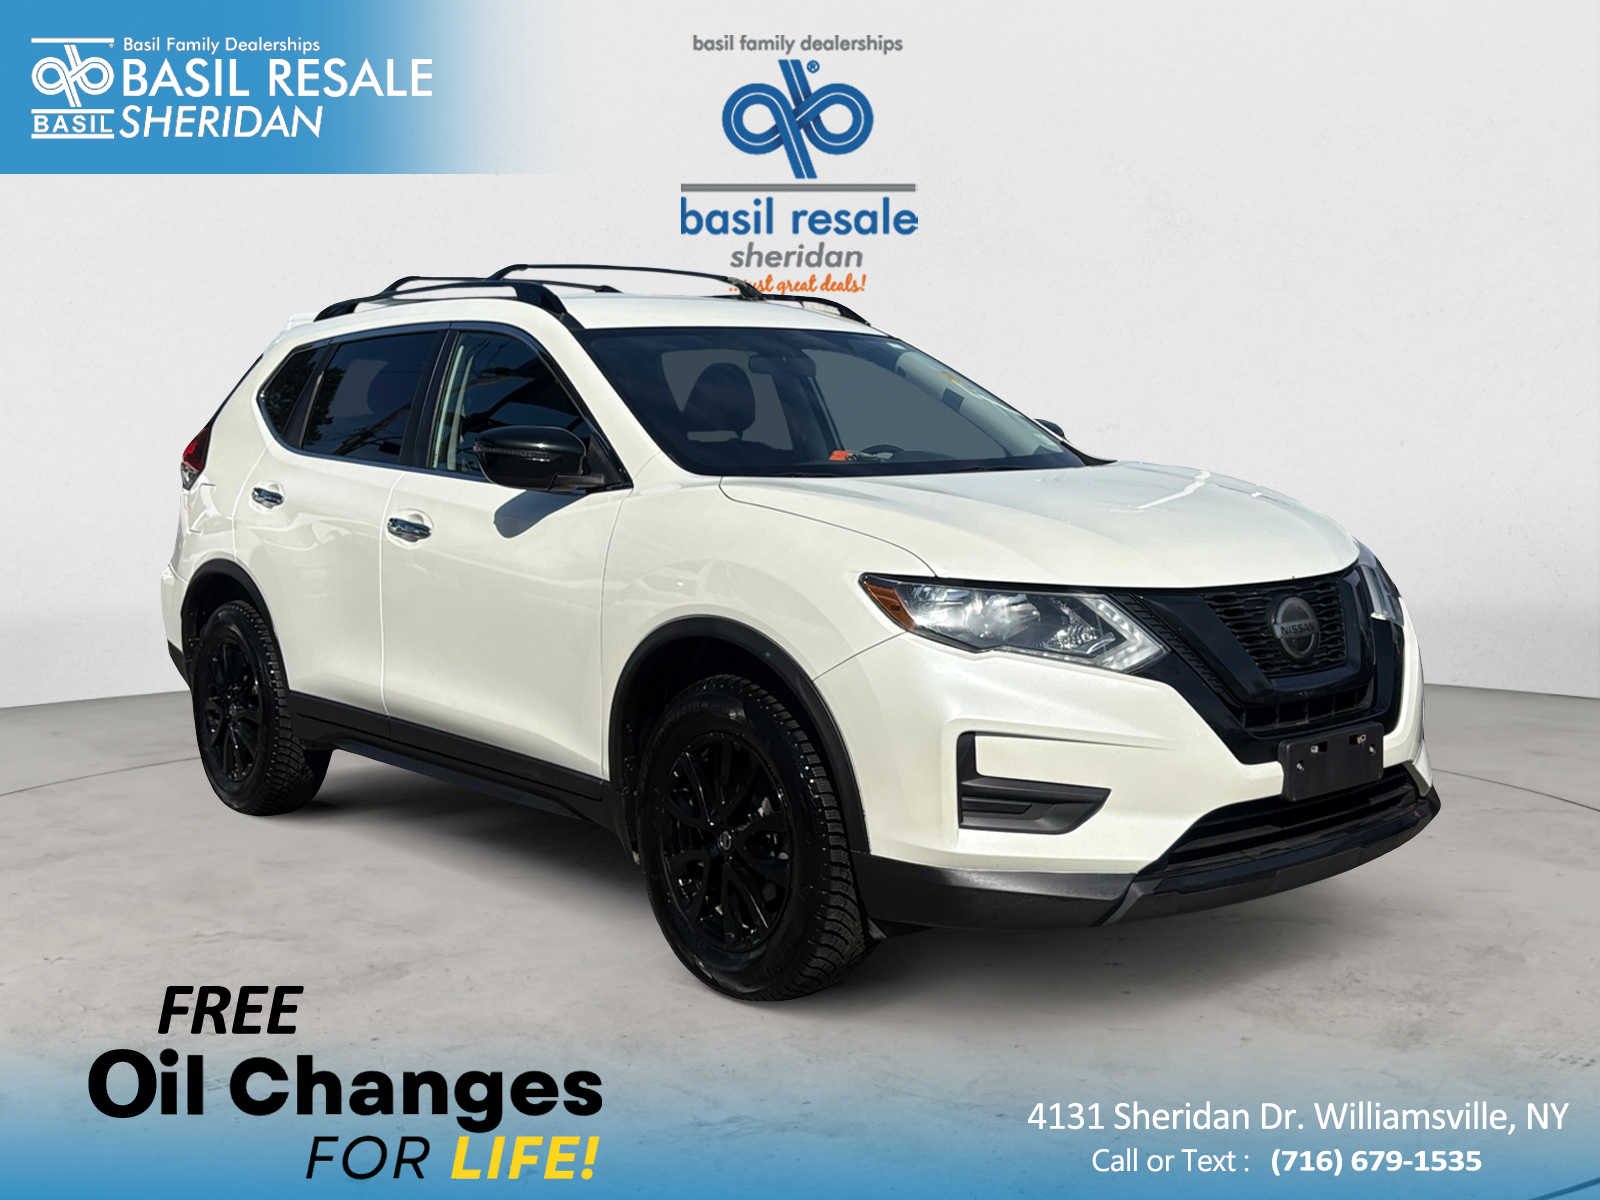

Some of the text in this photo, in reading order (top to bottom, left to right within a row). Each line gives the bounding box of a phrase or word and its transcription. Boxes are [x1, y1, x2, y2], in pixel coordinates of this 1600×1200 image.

[693, 35, 904, 55] basil family dealerships
[680, 196, 919, 235] basil resale
[730, 241, 863, 268] sheridan
[776, 274, 818, 295] great
[819, 272, 867, 293] deals!
